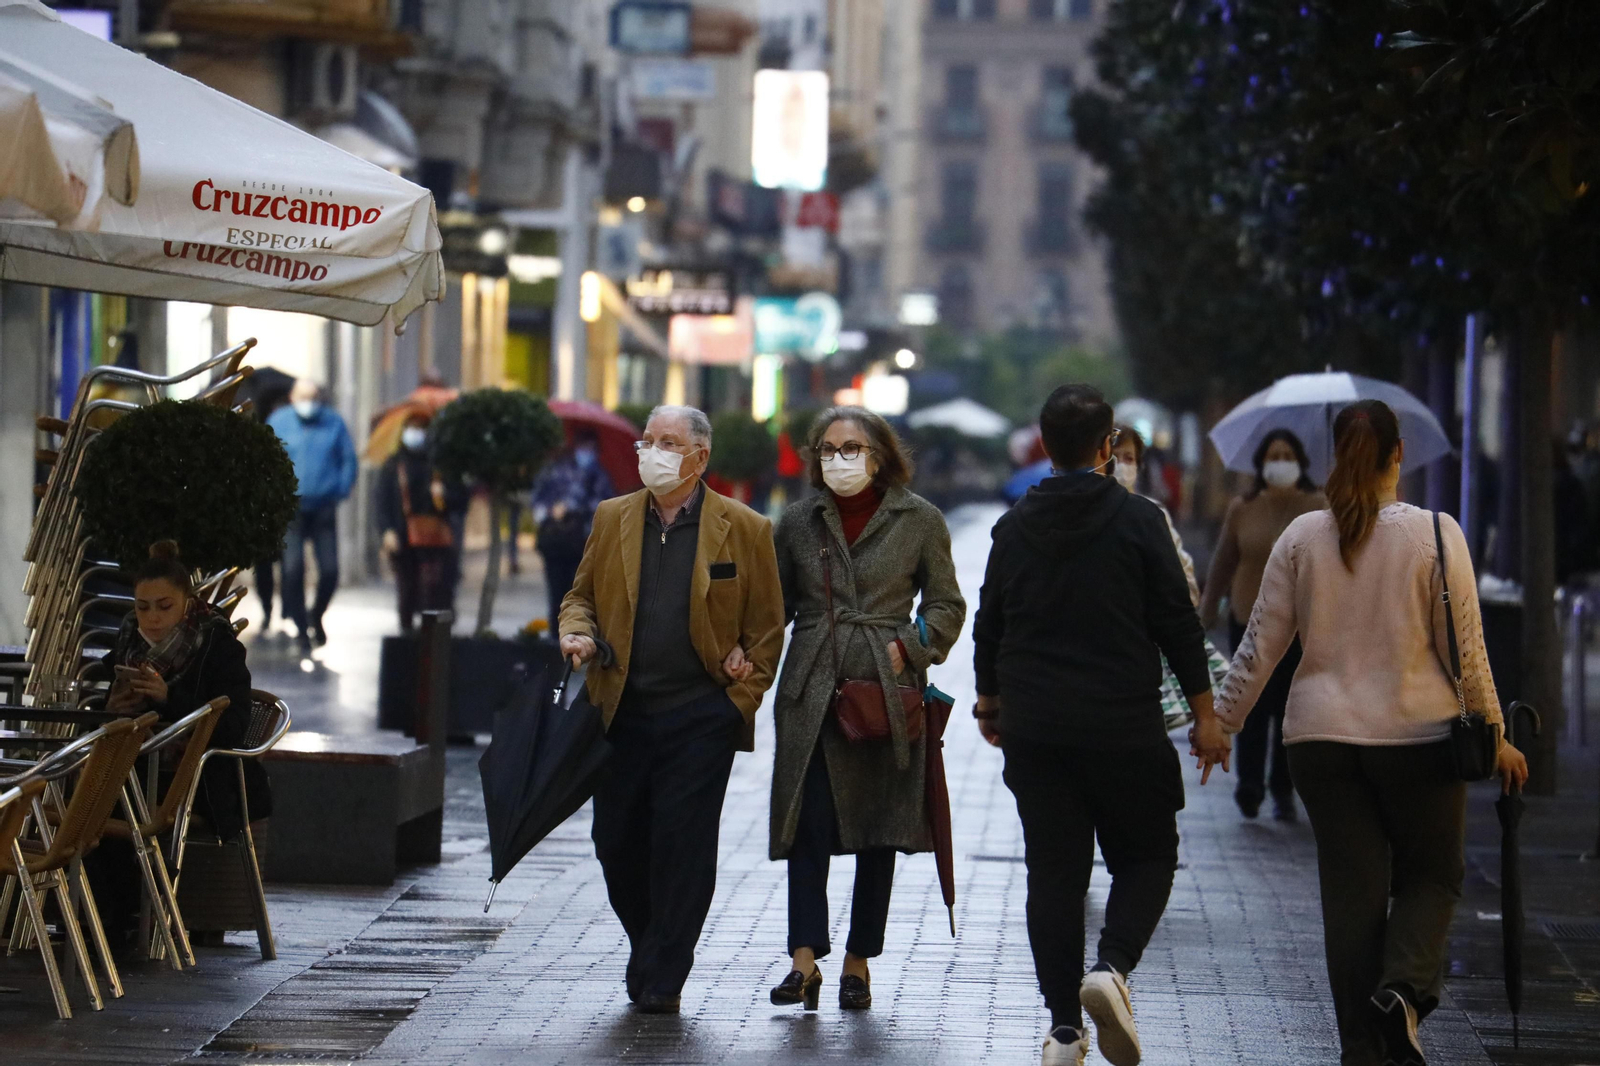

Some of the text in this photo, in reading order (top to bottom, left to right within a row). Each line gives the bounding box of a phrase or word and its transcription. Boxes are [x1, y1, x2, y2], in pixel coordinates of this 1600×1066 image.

[242, 180, 334, 198] DESDE 1904
[192, 178, 382, 231] Cruzcampo
[226, 227, 333, 251] ESPECIAL
